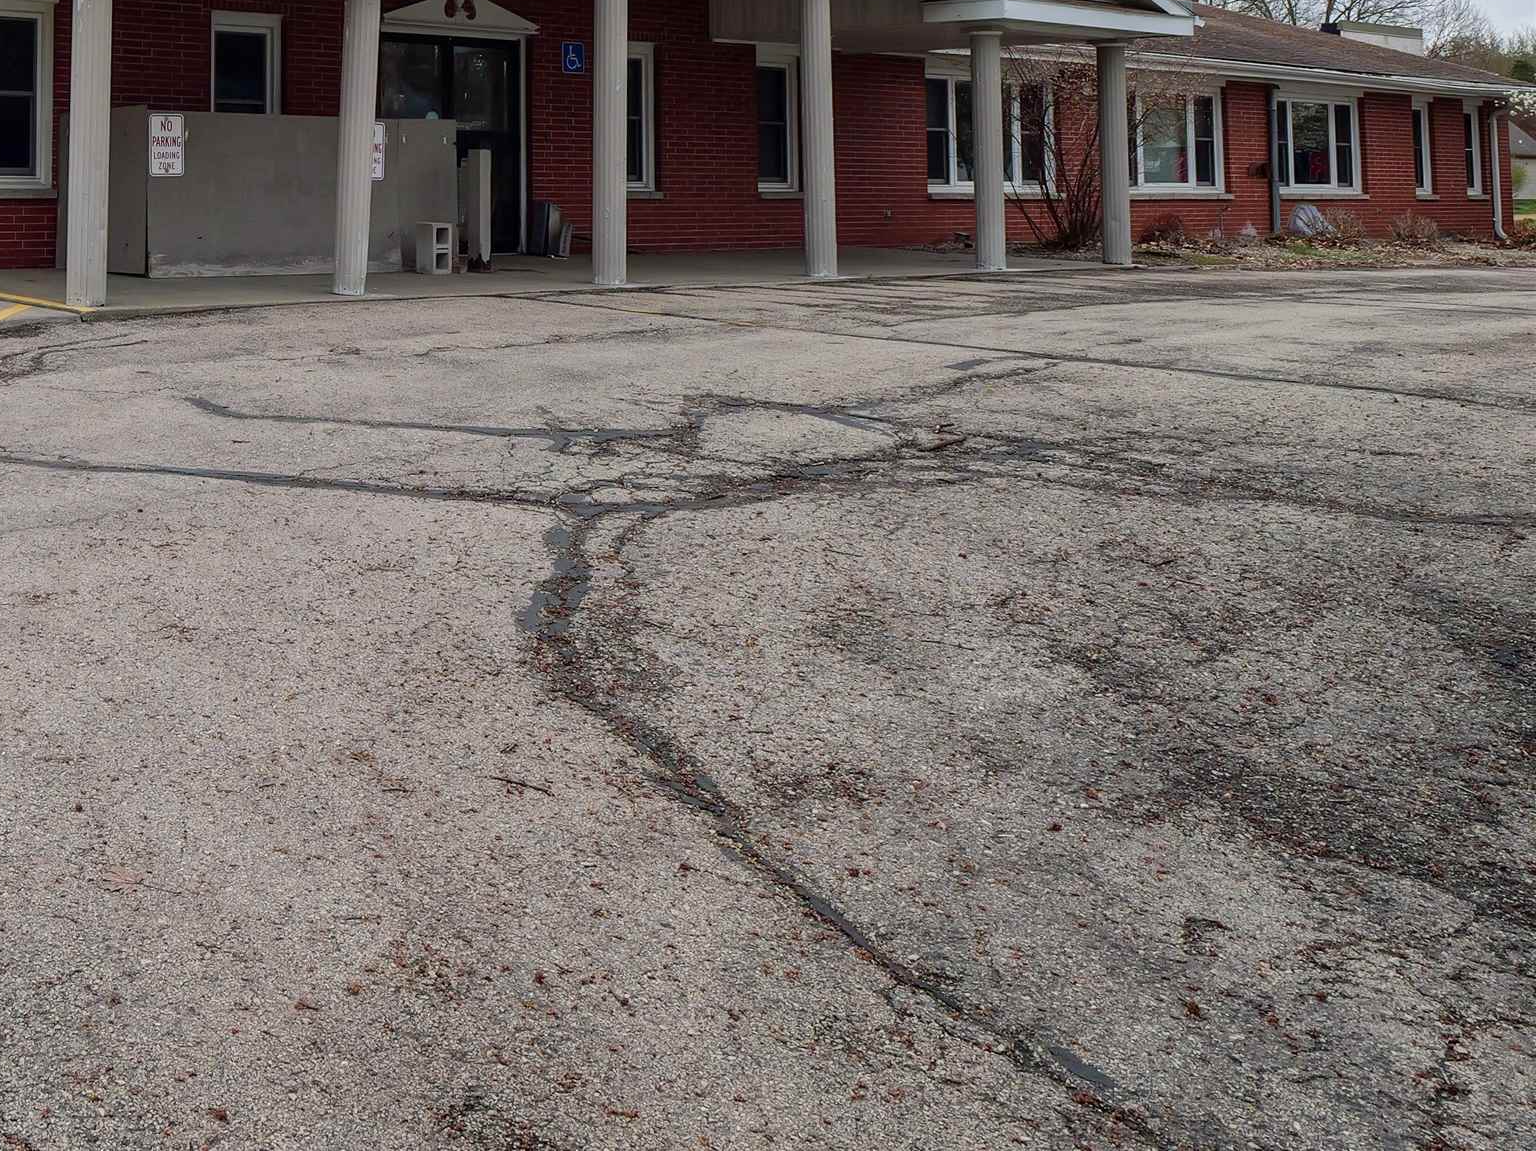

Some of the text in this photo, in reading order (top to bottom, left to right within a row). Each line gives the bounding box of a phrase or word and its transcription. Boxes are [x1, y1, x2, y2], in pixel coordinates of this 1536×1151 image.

[160, 120, 173, 132] NO
[152, 136, 182, 148] PARKING
[153, 151, 180, 160] LOADING
[158, 161, 176, 170] ZONE
